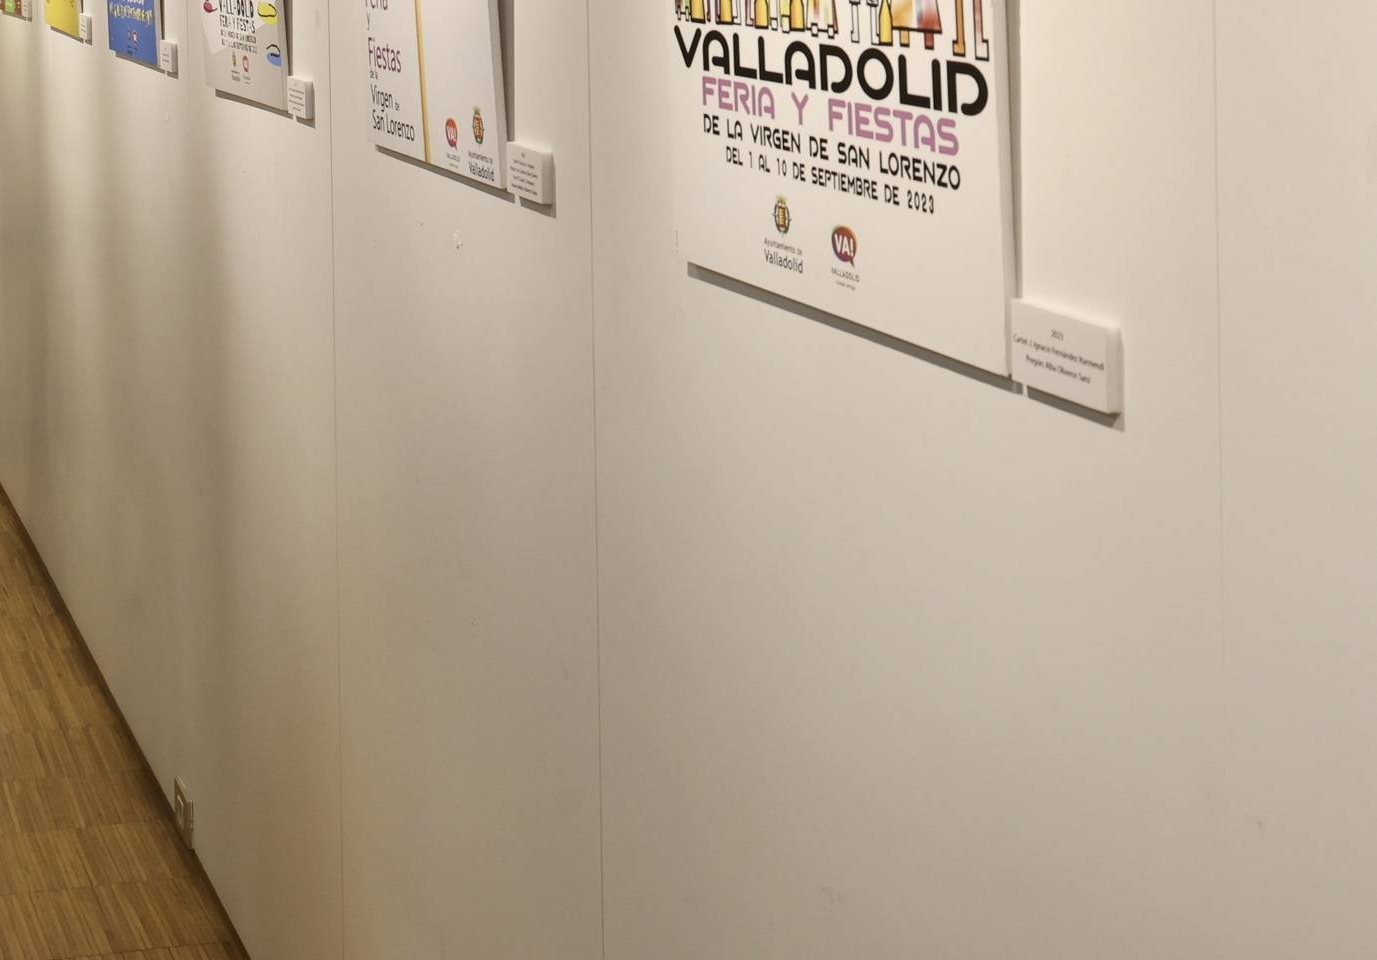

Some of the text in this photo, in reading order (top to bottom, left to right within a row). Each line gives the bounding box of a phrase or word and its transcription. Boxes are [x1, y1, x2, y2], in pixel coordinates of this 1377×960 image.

[368, 37, 402, 74] Fiestas
[674, 25, 989, 117] VALLADOLID
[370, 83, 394, 113] Virgen
[372, 108, 415, 142] San Lorenzo
[702, 76, 960, 157] FERIA Y FIESTAS
[703, 113, 961, 191] DE LA VIRGEN DE SAN LORENZO
[468, 160, 495, 183] Valladolid
[726, 146, 936, 216] DEL 1 AL 10 DE SEPTIEMBRE DE 2023
[764, 238, 796, 254] Ayuntamiento
[764, 248, 804, 274] Valladolid
[834, 233, 855, 257] VA!
